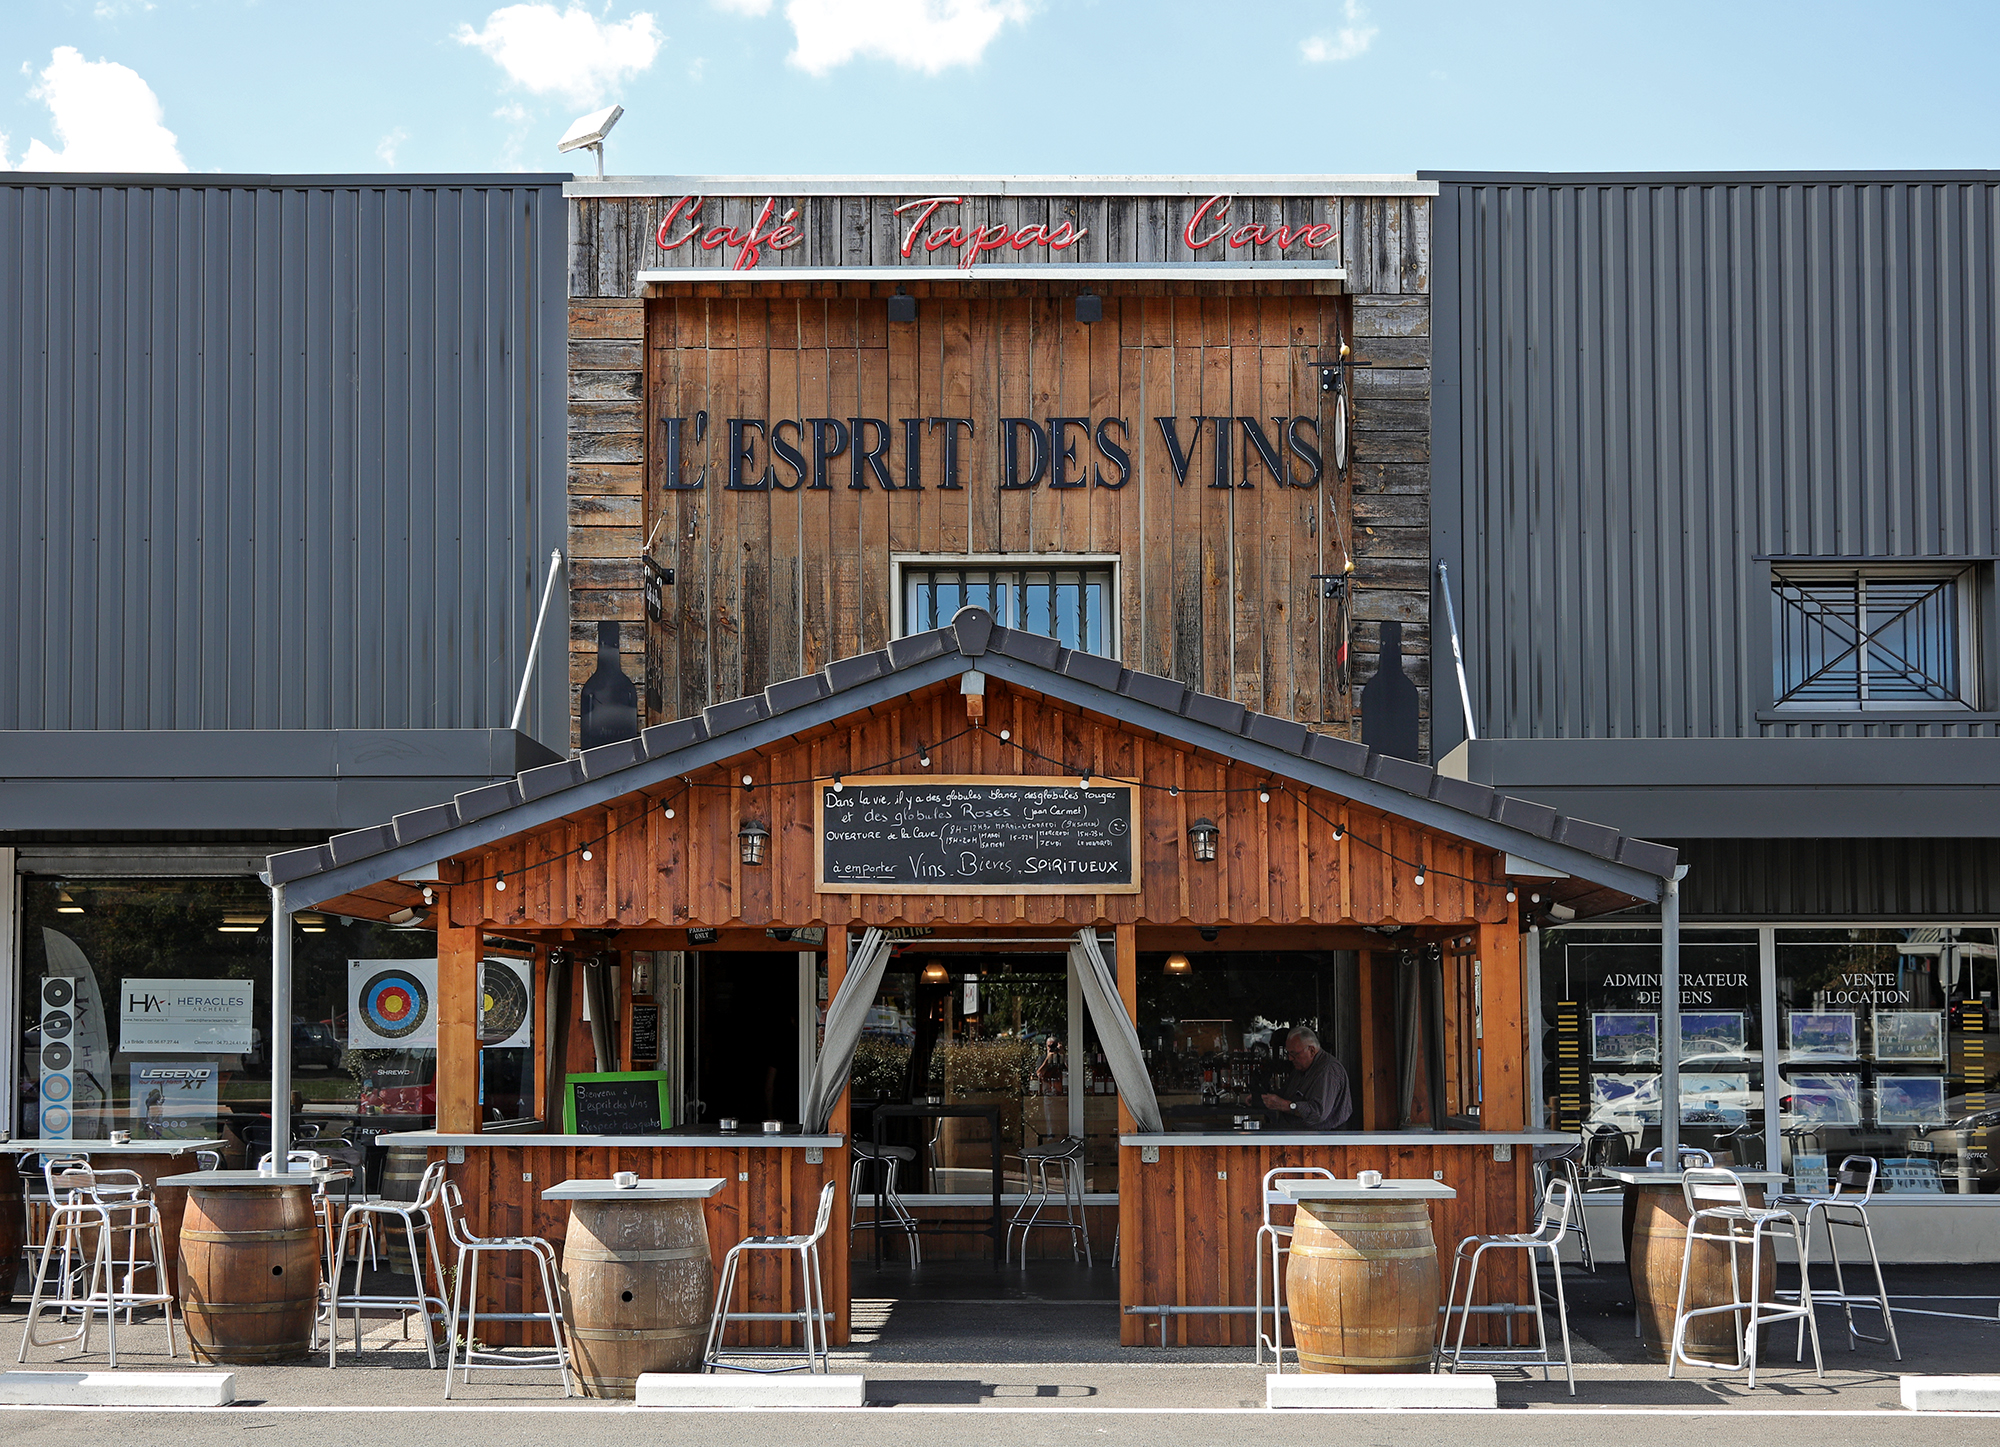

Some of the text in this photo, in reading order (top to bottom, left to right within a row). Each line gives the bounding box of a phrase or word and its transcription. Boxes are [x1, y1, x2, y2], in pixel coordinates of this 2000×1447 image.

[656, 191, 1340, 271] Café Tapas Cave
[661, 410, 1323, 491] L'ESPRIT DES VINS
[825, 792, 854, 808] Dans
[926, 791, 941, 803] des
[941, 789, 982, 807] globules
[1085, 791, 1117, 805] rouges
[841, 811, 853, 823] et
[864, 809, 888, 822] des
[890, 806, 952, 827] globules
[826, 830, 881, 842] OUVERTURE
[887, 831, 898, 841] de
[912, 826, 938, 840] Cave
[833, 860, 842, 873] à
[844, 861, 898, 877] emporter
[694, 931, 709, 940] ONLY
[1841, 973, 1896, 986] VENTE
[177, 997, 244, 1006] HERACLES
[1826, 990, 1911, 1004] LOCATION
[140, 1068, 211, 1079] LEGEND
[180, 1079, 206, 1090] XT
